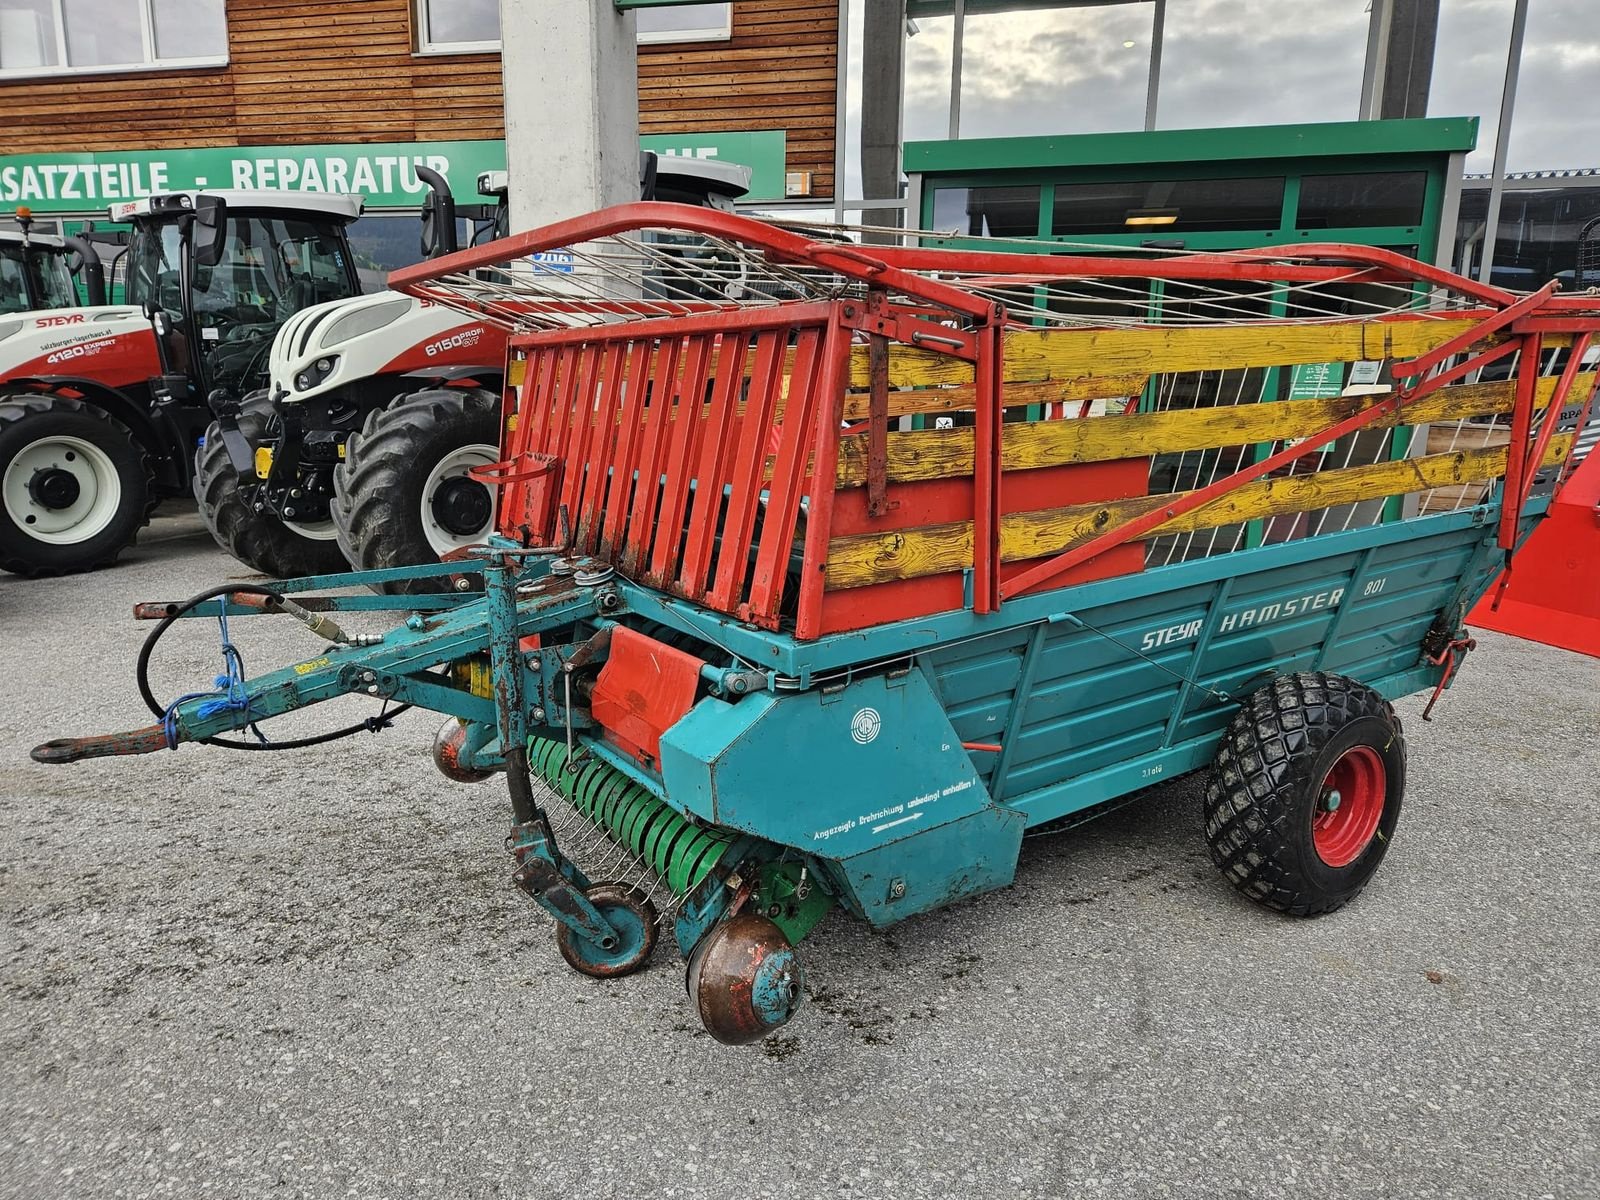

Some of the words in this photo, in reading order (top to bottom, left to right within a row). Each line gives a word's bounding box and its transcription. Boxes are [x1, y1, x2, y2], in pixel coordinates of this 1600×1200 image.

[0, 162, 169, 201] SATZTEILE
[231, 156, 449, 194] REPARATUR
[36, 314, 85, 328] STEYR
[40, 329, 112, 351] salzburger-lagerhaus.at
[47, 346, 84, 363] 4120
[84, 339, 116, 350] EXPERT
[425, 335, 462, 357] 6150
[460, 328, 484, 340] PROFI
[1141, 619, 1203, 650] STEYR
[1219, 588, 1345, 633] HAMSTER
[1363, 577, 1387, 596] 801
